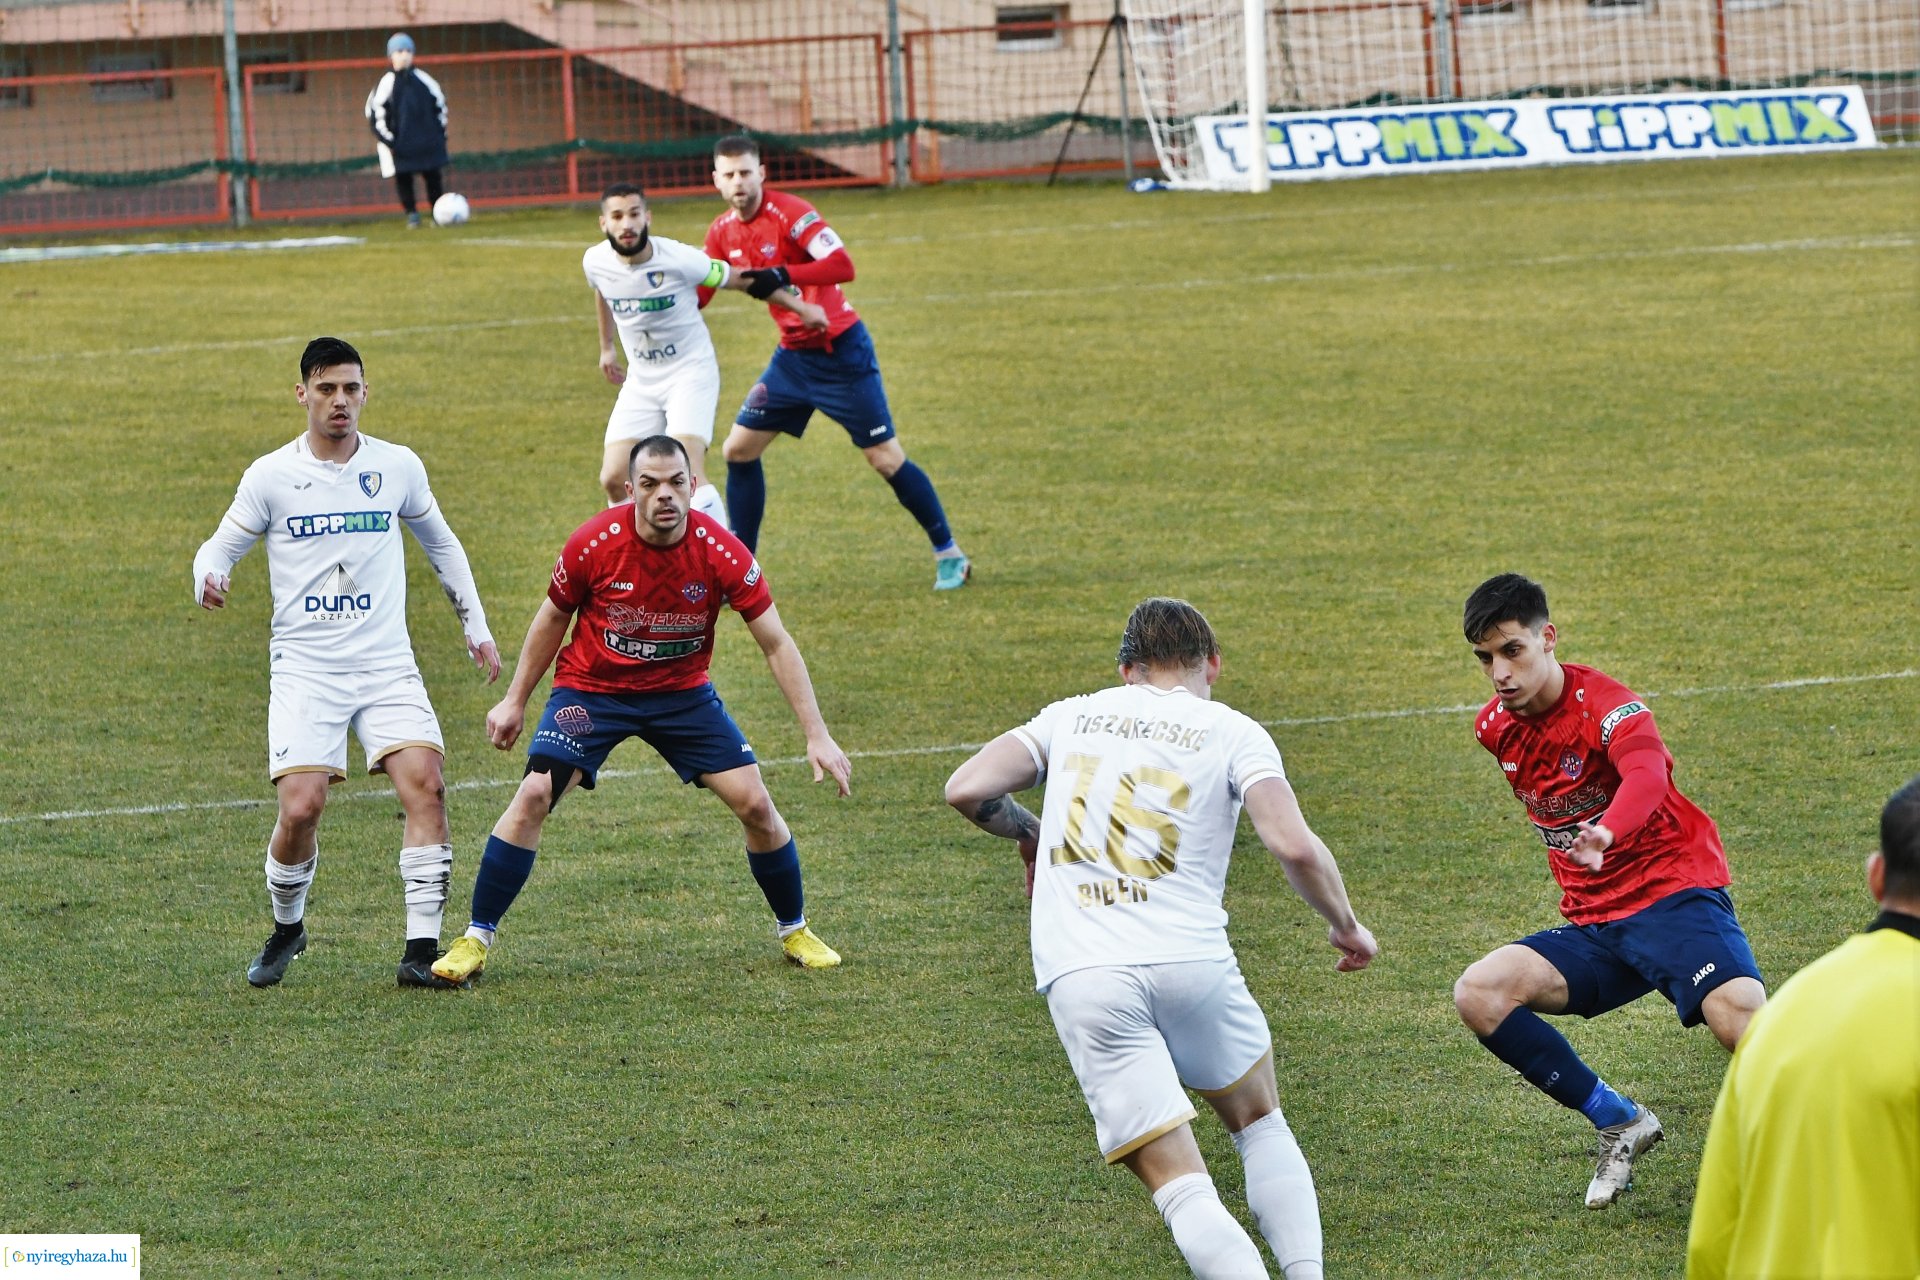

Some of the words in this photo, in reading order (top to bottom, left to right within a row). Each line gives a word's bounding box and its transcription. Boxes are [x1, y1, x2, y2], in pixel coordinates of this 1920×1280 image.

[311, 612, 367, 622] ASZFALT
[1050, 752, 1192, 881] 16
[1077, 877, 1149, 909] BIBEN
[1692, 962, 1716, 987] JAKO
